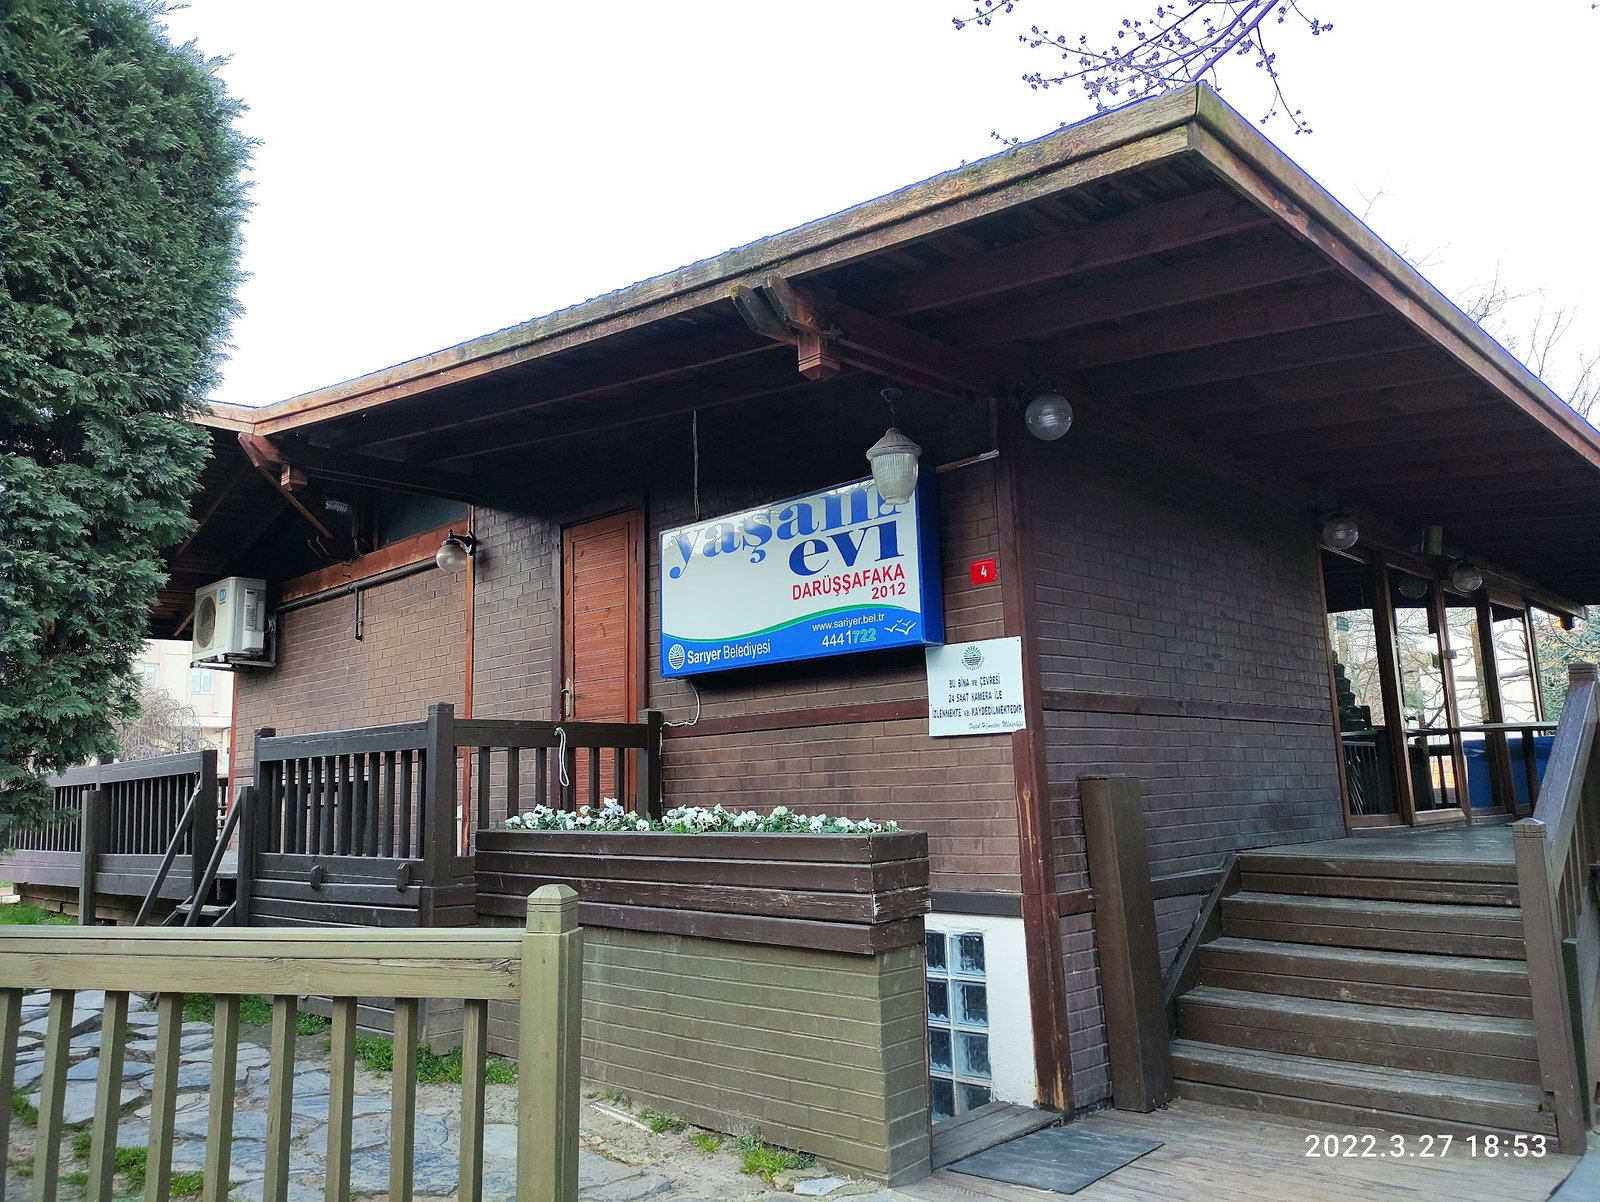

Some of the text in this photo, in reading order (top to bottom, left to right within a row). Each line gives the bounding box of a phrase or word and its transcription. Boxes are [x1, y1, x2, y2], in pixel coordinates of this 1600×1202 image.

[788, 507, 905, 576] evi
[980, 564, 988, 578] 4
[792, 563, 905, 601] DARÜŞŞAFAKA
[871, 581, 907, 600] 2012
[812, 613, 886, 632] www.sariyer.bel.tr
[723, 639, 771, 660] Belediyesi
[980, 673, 1001, 688] ÇEVRESİ
[957, 692, 969, 702] SAAT
[971, 691, 992, 702] KAMERA
